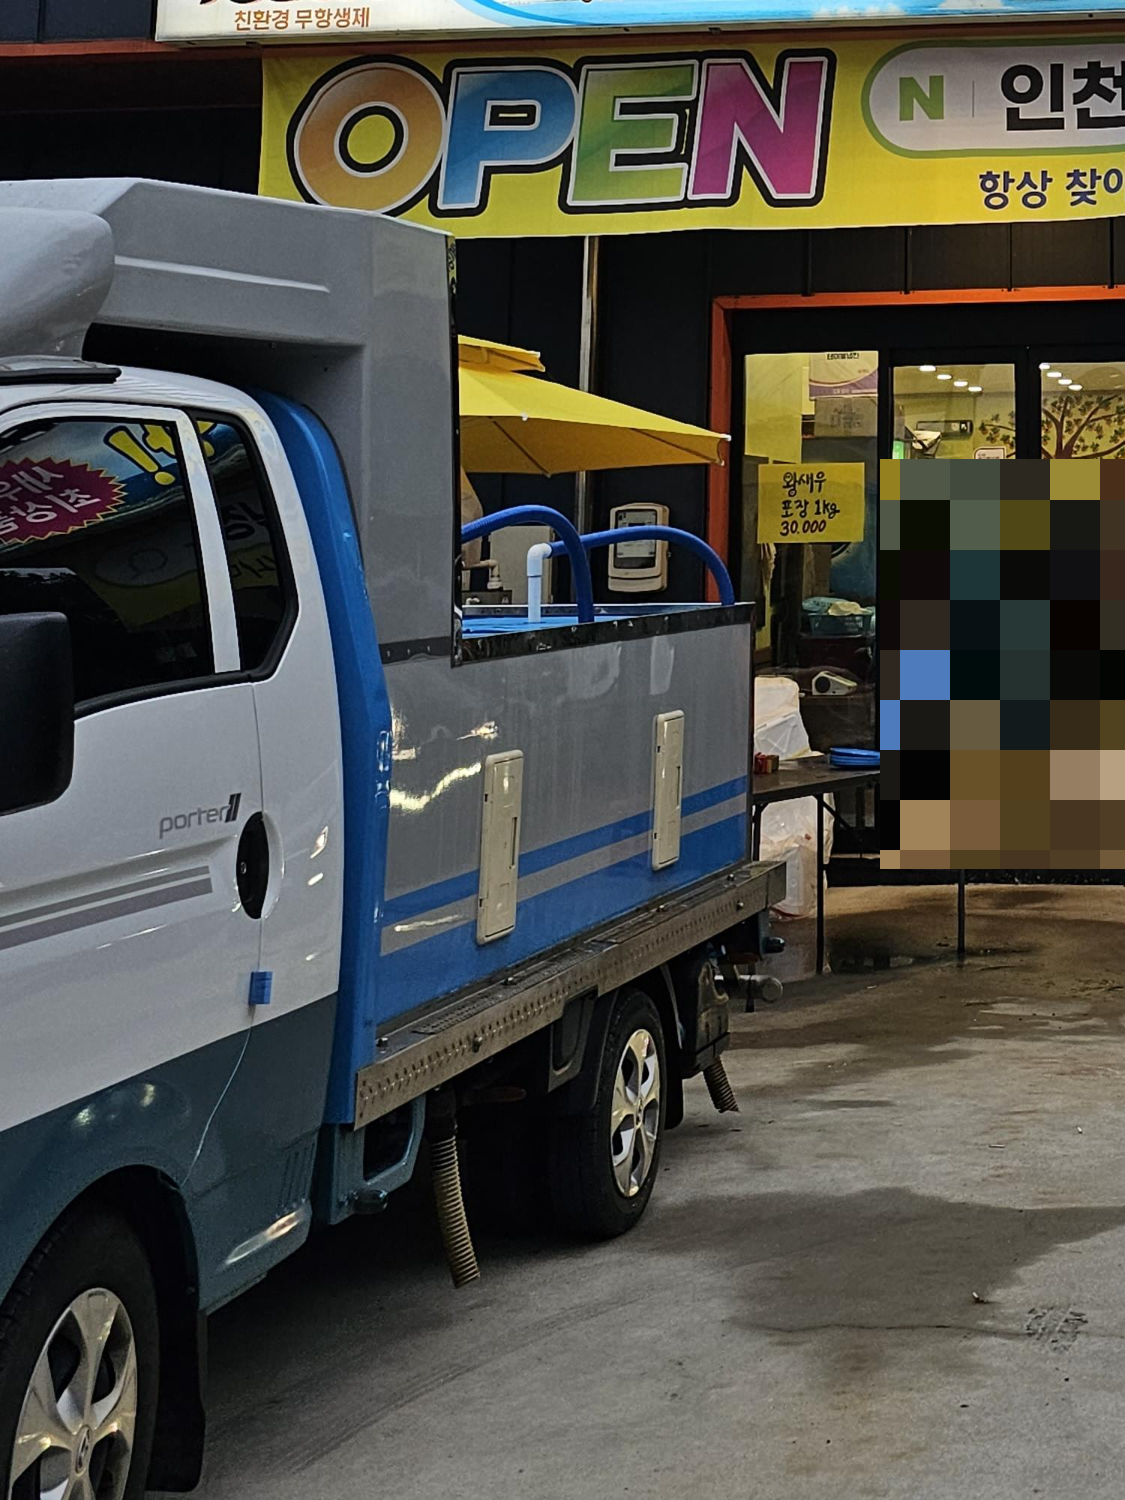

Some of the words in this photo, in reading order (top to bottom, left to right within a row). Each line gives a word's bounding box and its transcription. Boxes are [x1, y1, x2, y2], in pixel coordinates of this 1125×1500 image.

[234, 9, 290, 31] 친환경
[295, 7, 370, 29] 무항생제
[899, 75, 945, 122] N
[287, 48, 836, 218] OPEN
[979, 170, 1053, 211] 항상
[782, 471, 827, 497] 왕새우
[781, 499, 809, 518] 포장
[814, 499, 841, 519] 1kg
[780, 519, 827, 537] 30.000
